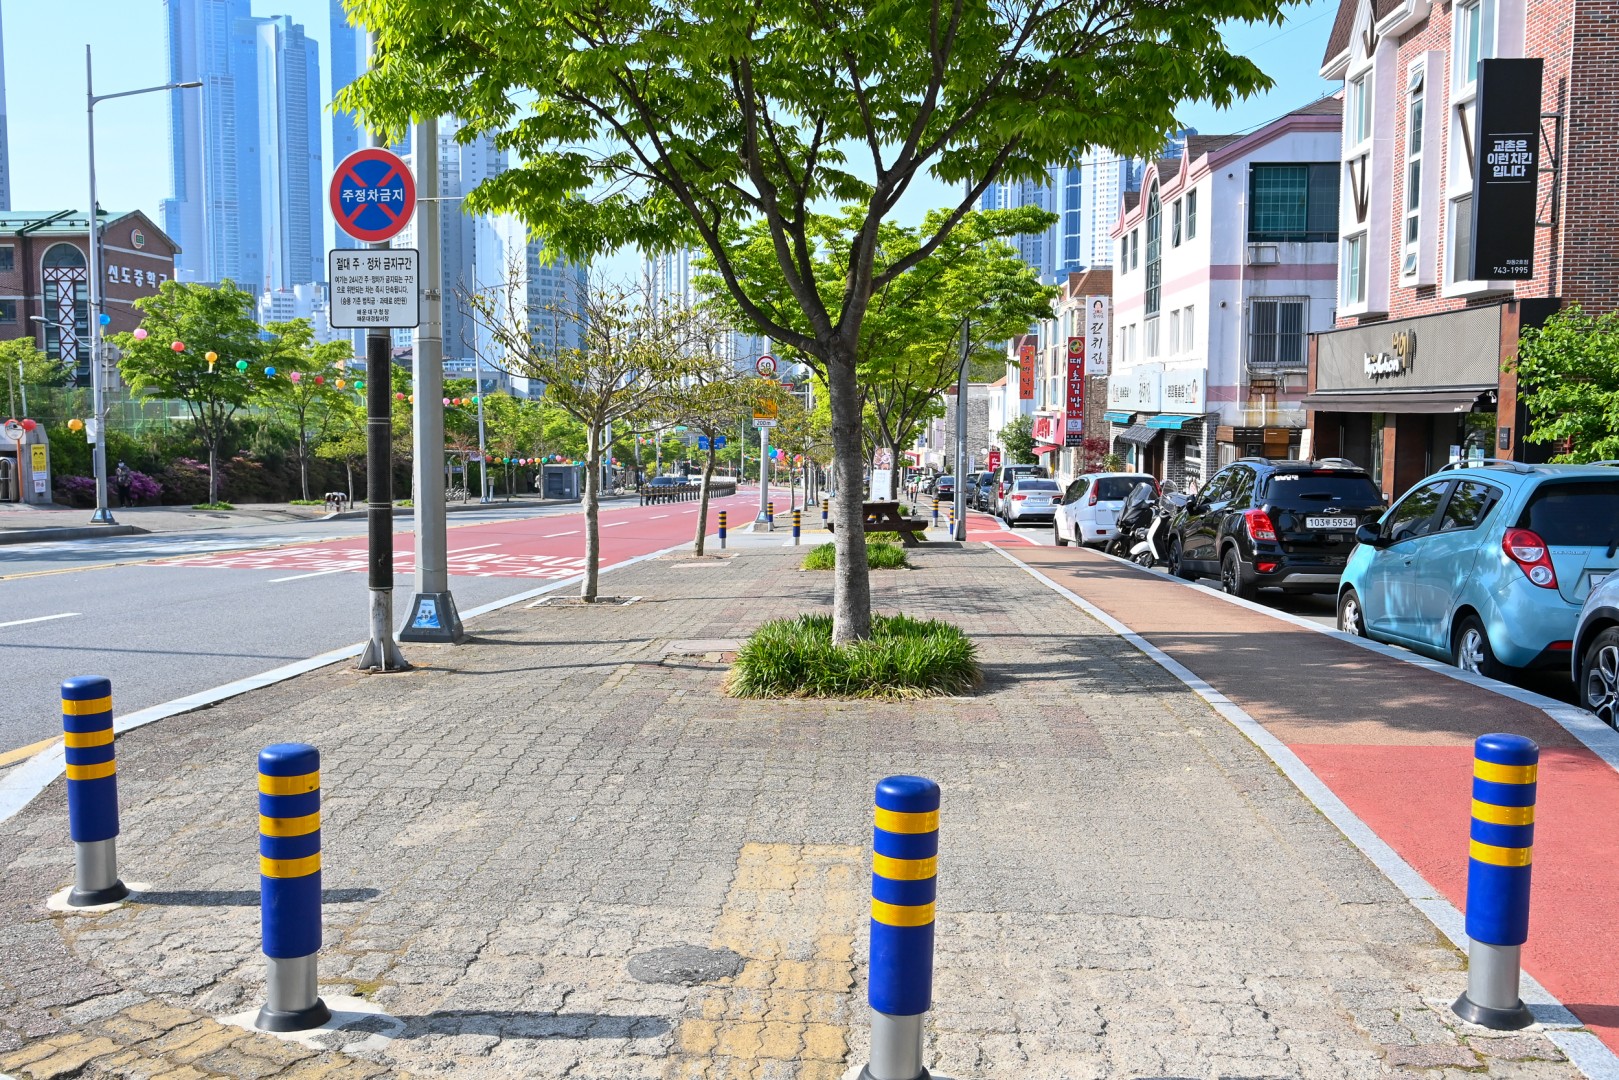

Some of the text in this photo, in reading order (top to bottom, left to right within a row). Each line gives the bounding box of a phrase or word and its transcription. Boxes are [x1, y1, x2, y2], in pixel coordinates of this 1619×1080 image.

[1493, 140, 1528, 152] 교촌은
[1487, 152, 1533, 165] 이런 치킨
[1492, 165, 1526, 178] 입니다
[342, 188, 403, 203] 주정차금지
[337, 257, 350, 270] 절대
[383, 257, 412, 270] 금지구간
[1493, 266, 1528, 274] 743-1995
[335, 276, 348, 284] 여기는
[349, 276, 363, 284] 24시간
[385, 276, 403, 284] 금지되는
[404, 276, 414, 284] 구간
[1091, 322, 1104, 365] 잔치집
[1069, 357, 1082, 408] 땡초김밥
[1332, 518, 1354, 527] 5954
